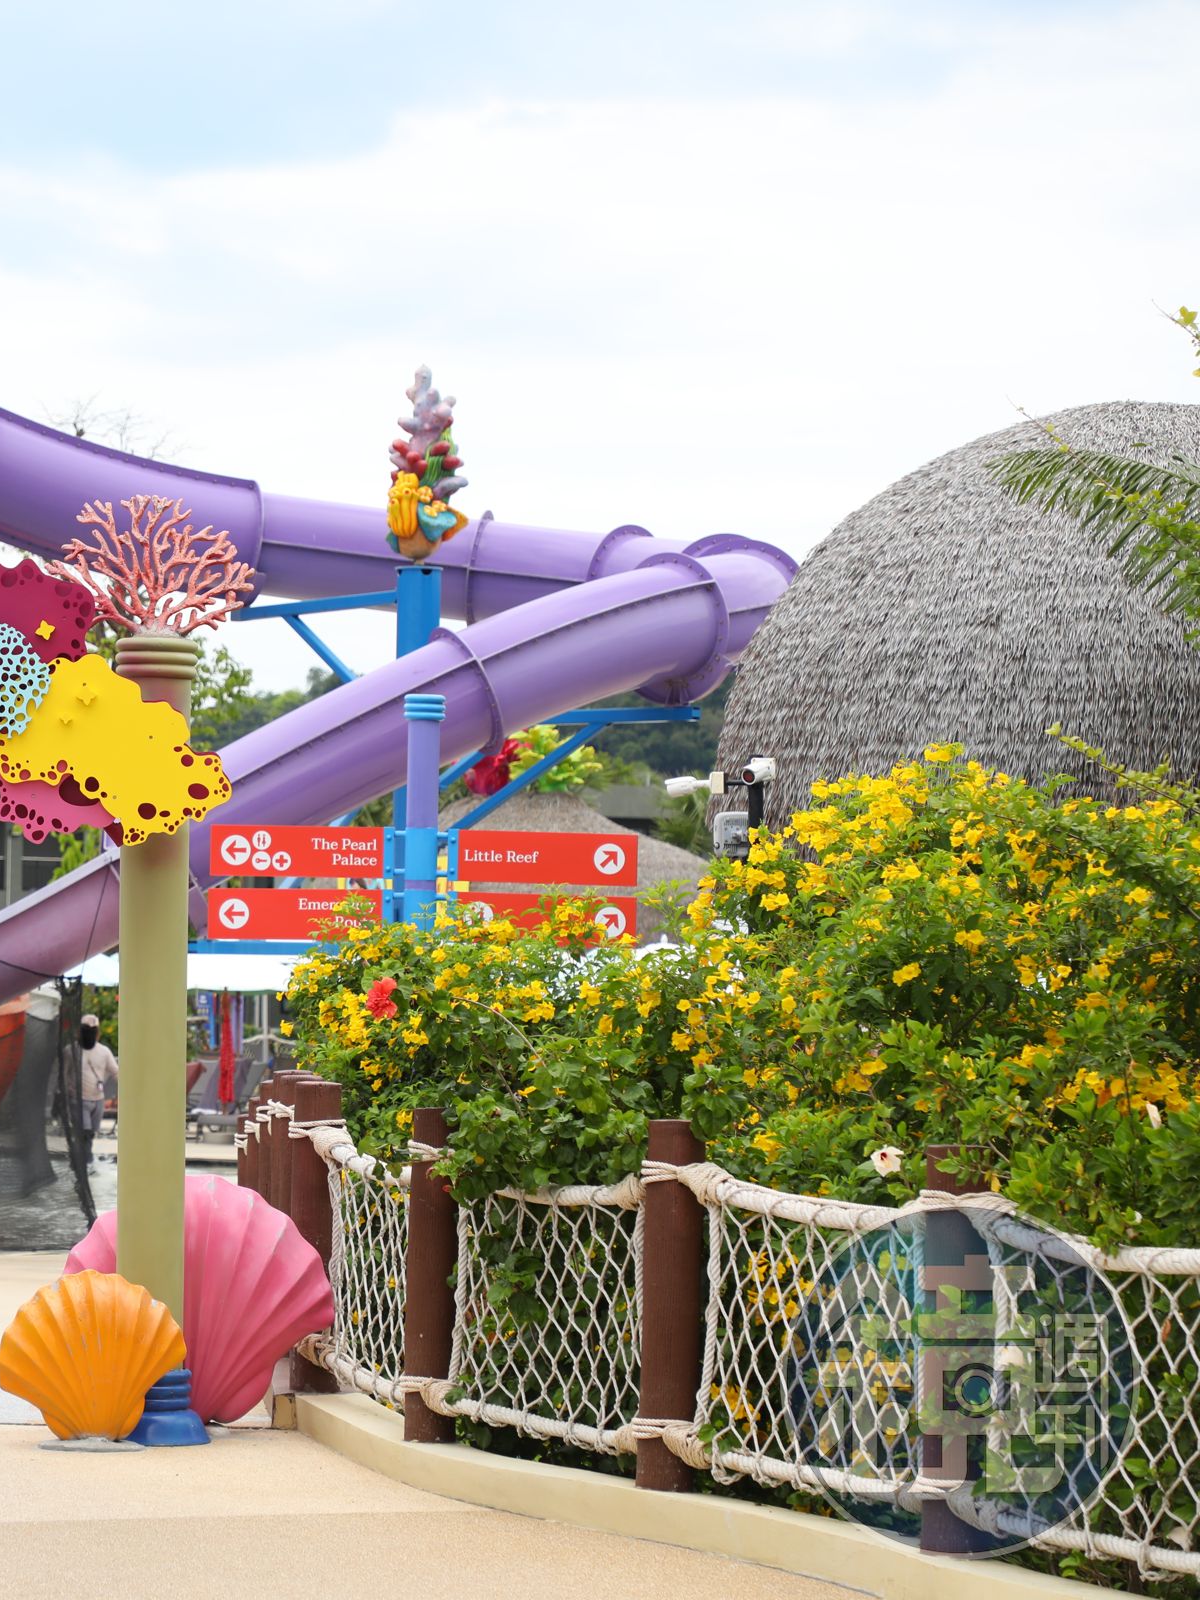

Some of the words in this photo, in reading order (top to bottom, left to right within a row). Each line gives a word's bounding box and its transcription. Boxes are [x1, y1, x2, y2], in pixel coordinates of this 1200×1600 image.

[311, 837, 338, 850] The
[341, 838, 377, 851] Pearl
[332, 853, 378, 866] Palace
[464, 849, 503, 863] Little
[506, 850, 539, 864] Reef
